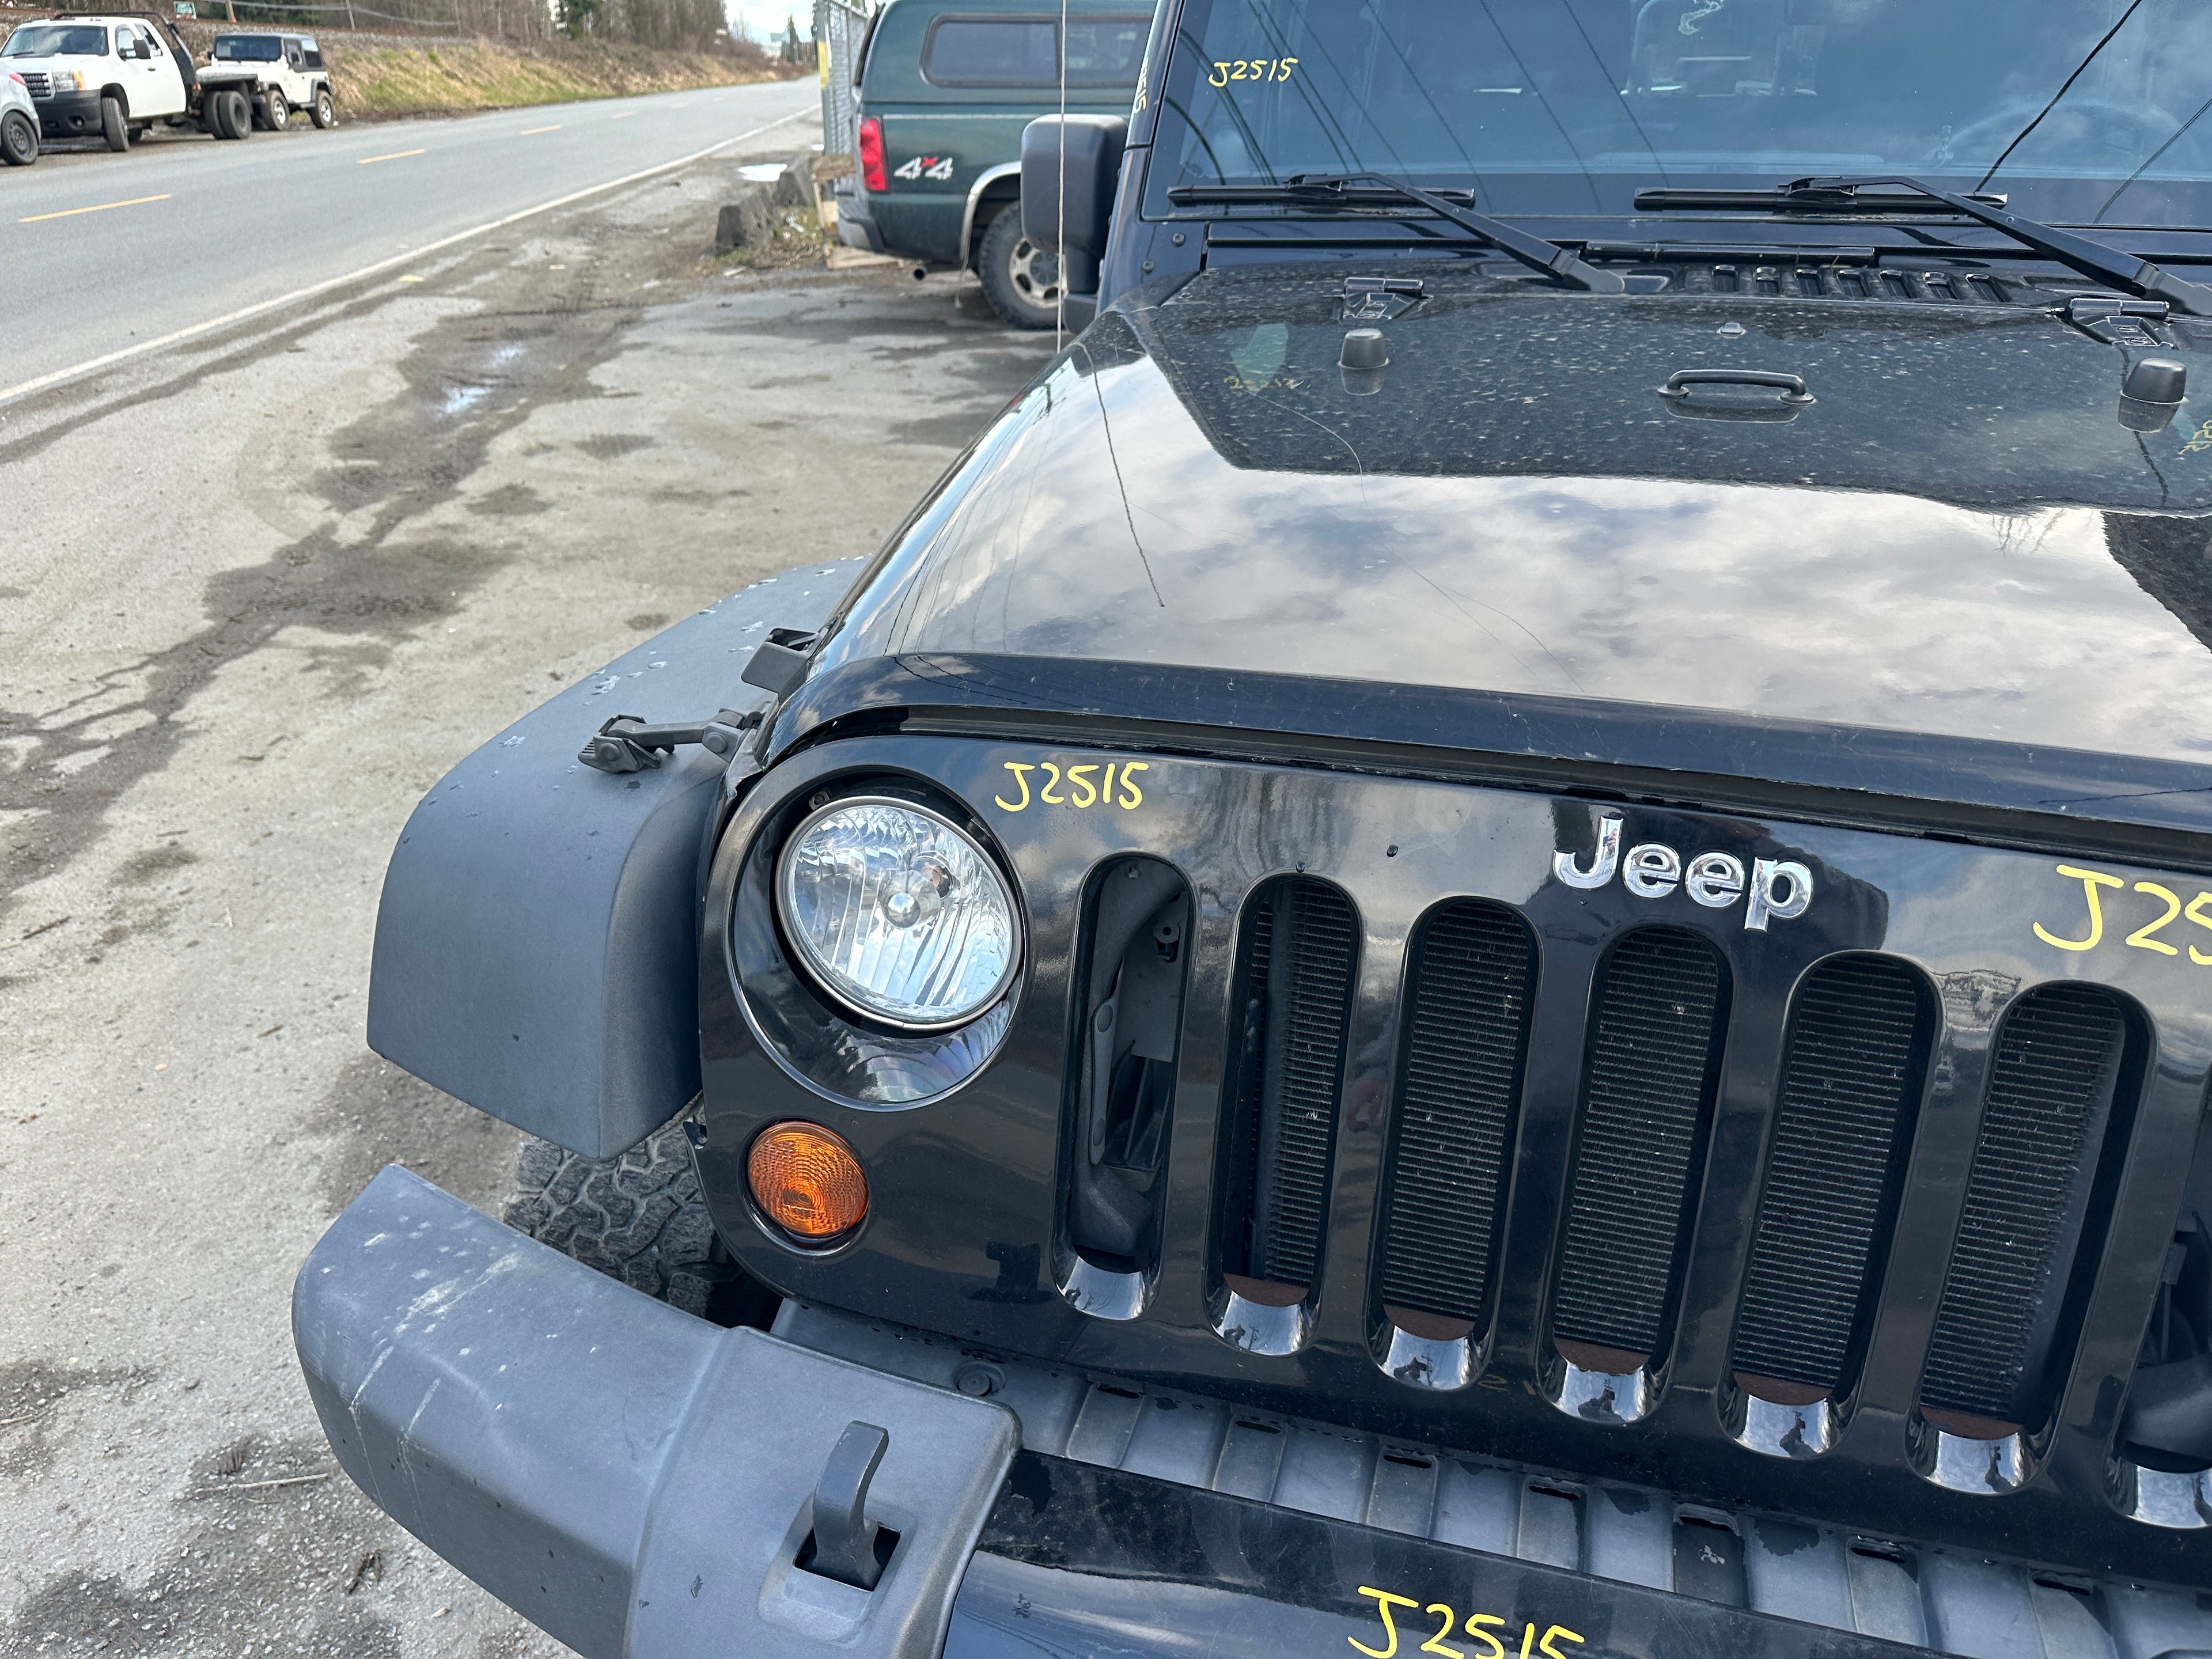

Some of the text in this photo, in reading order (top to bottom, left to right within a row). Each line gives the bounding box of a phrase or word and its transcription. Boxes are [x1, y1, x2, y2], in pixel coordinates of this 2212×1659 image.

[1209, 58, 1298, 87] J2515
[995, 762, 1149, 812] J2515
[1554, 816, 1813, 932] Jeep
[1347, 1585, 1585, 1659] J2515
